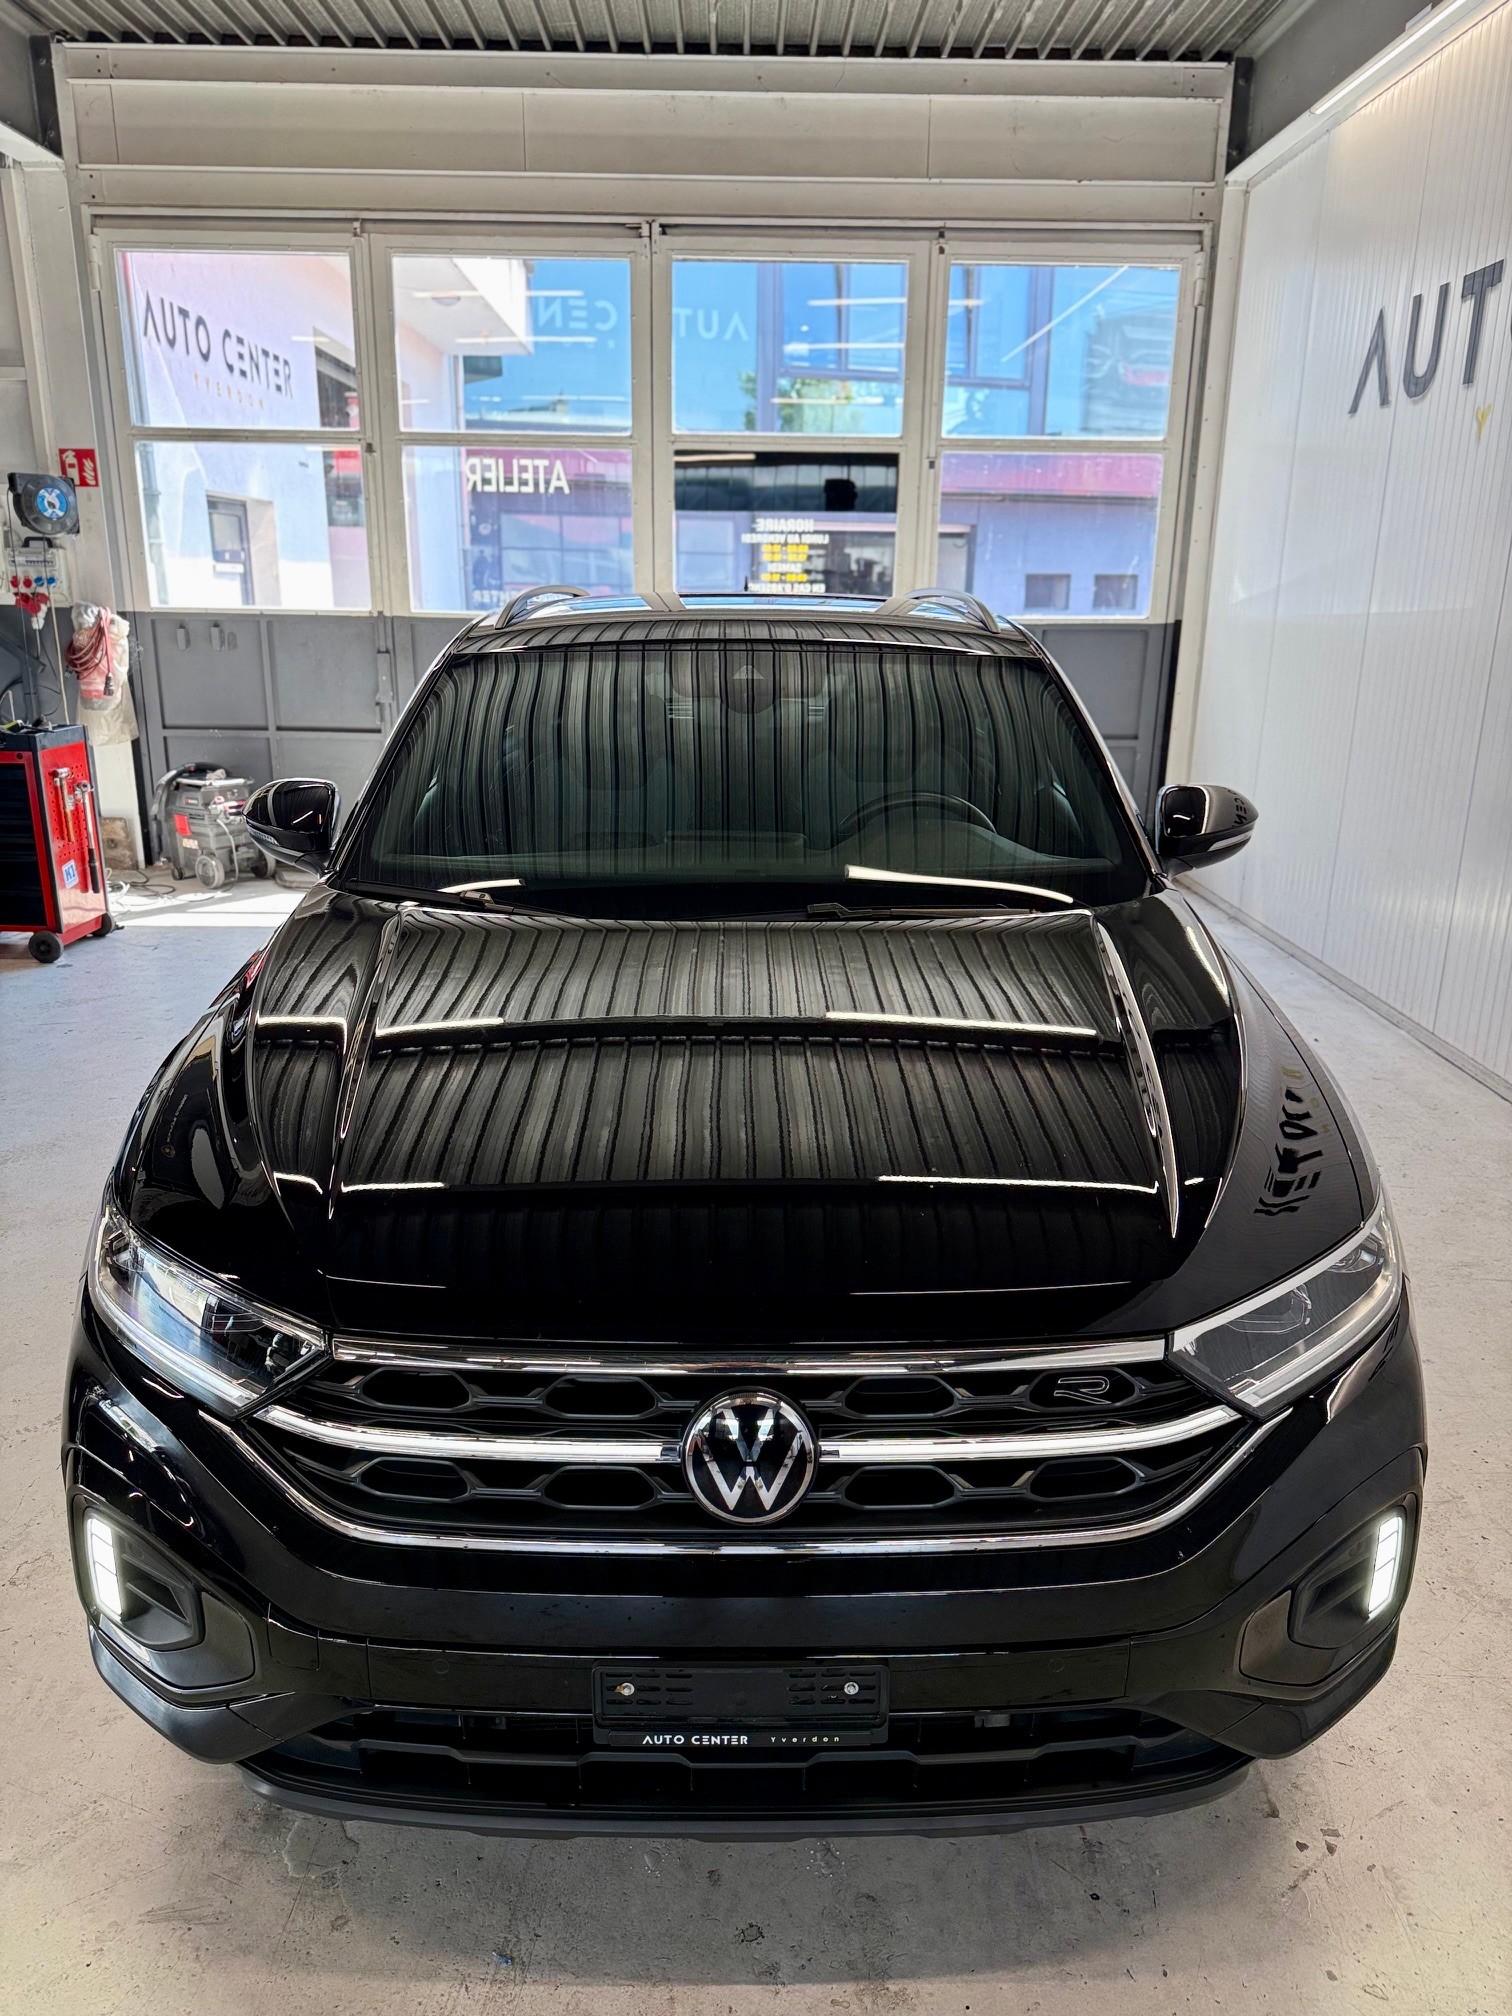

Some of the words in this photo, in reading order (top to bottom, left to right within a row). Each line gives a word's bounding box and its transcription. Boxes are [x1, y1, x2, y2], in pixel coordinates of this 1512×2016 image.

[143, 289, 211, 362] AUTO
[222, 328, 293, 399] CENTER
[1348, 258, 1512, 415] AUT
[641, 1734, 685, 1745] AUTO
[691, 1734, 749, 1745] CENTER
[770, 1735, 840, 1743] Yverdon
